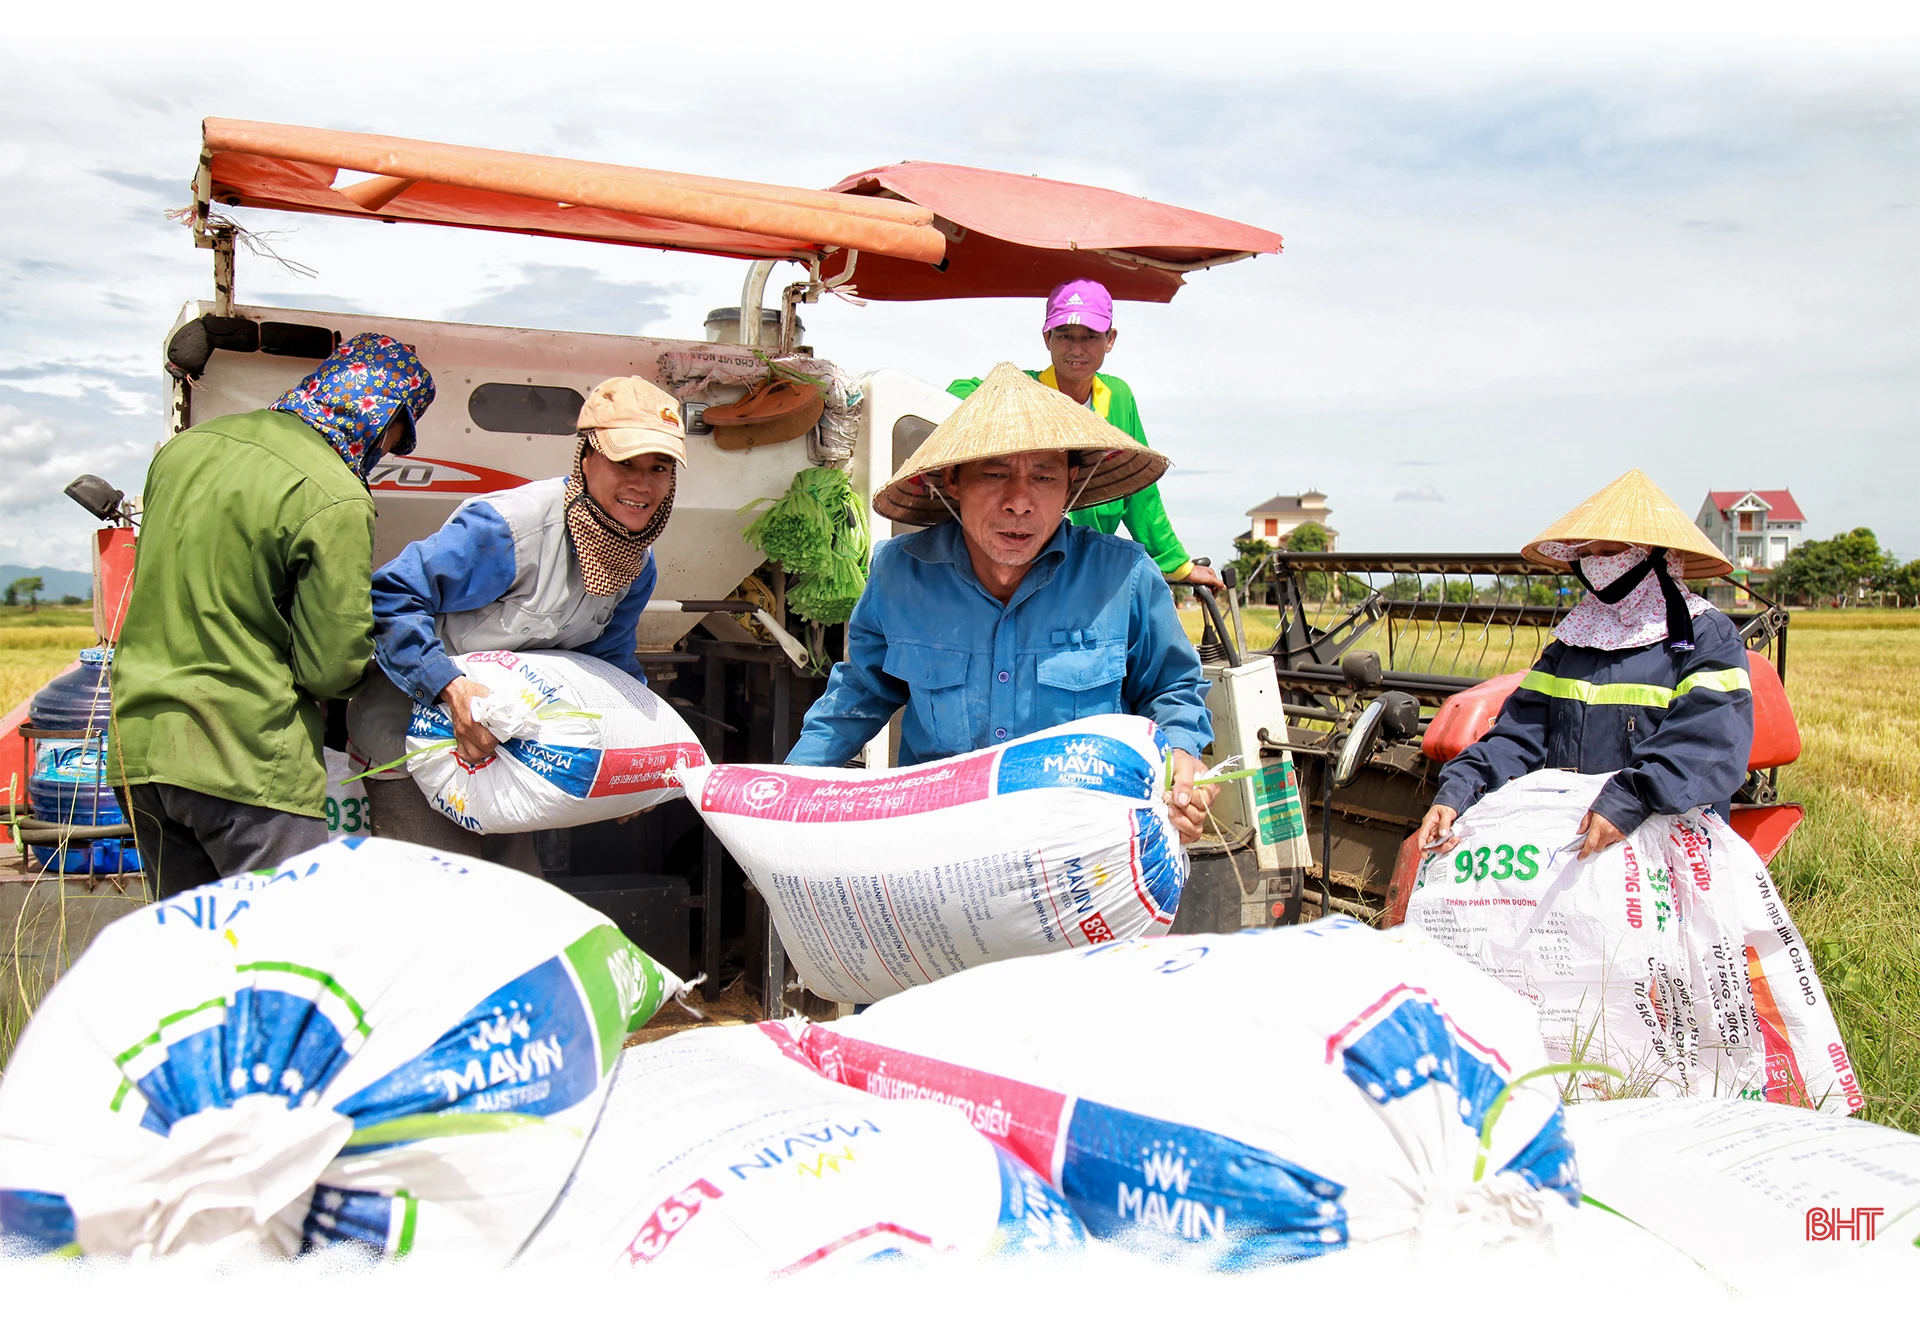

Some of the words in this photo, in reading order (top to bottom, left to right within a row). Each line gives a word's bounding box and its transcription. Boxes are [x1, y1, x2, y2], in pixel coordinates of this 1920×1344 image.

[519, 664, 561, 705] MAVIN
[520, 740, 573, 770] MAVIN
[1043, 754, 1115, 777] MAVIN
[867, 781, 896, 795] CHO
[896, 777, 924, 790] HEO
[867, 795, 883, 808] 25
[435, 793, 483, 831] MAVIN
[1455, 843, 1540, 884] 933S
[1064, 857, 1094, 913] MAVIN
[844, 906, 856, 921] DẪN
[1034, 900, 1046, 917] DINH
[1493, 898, 1511, 906] DINH
[1625, 897, 1643, 930] HUP
[850, 922, 861, 934] SỬ
[871, 876, 883, 902] THÀNH
[879, 903, 892, 925] PHẦN
[887, 924, 903, 953] NGUYÊN
[898, 950, 911, 963] LIỆU
[855, 932, 868, 949] DỤNG
[1712, 944, 1725, 960] TỪ
[1789, 947, 1806, 974] HEO
[1717, 964, 1731, 1004] 15KG
[1799, 975, 1816, 1006] CHO
[1724, 1011, 1740, 1045] 30KG
[441, 1033, 564, 1102] MAVIN
[1827, 1042, 1849, 1073] HUP
[973, 1099, 1012, 1138] SIÊU
[1117, 1180, 1227, 1242] MAVIN
